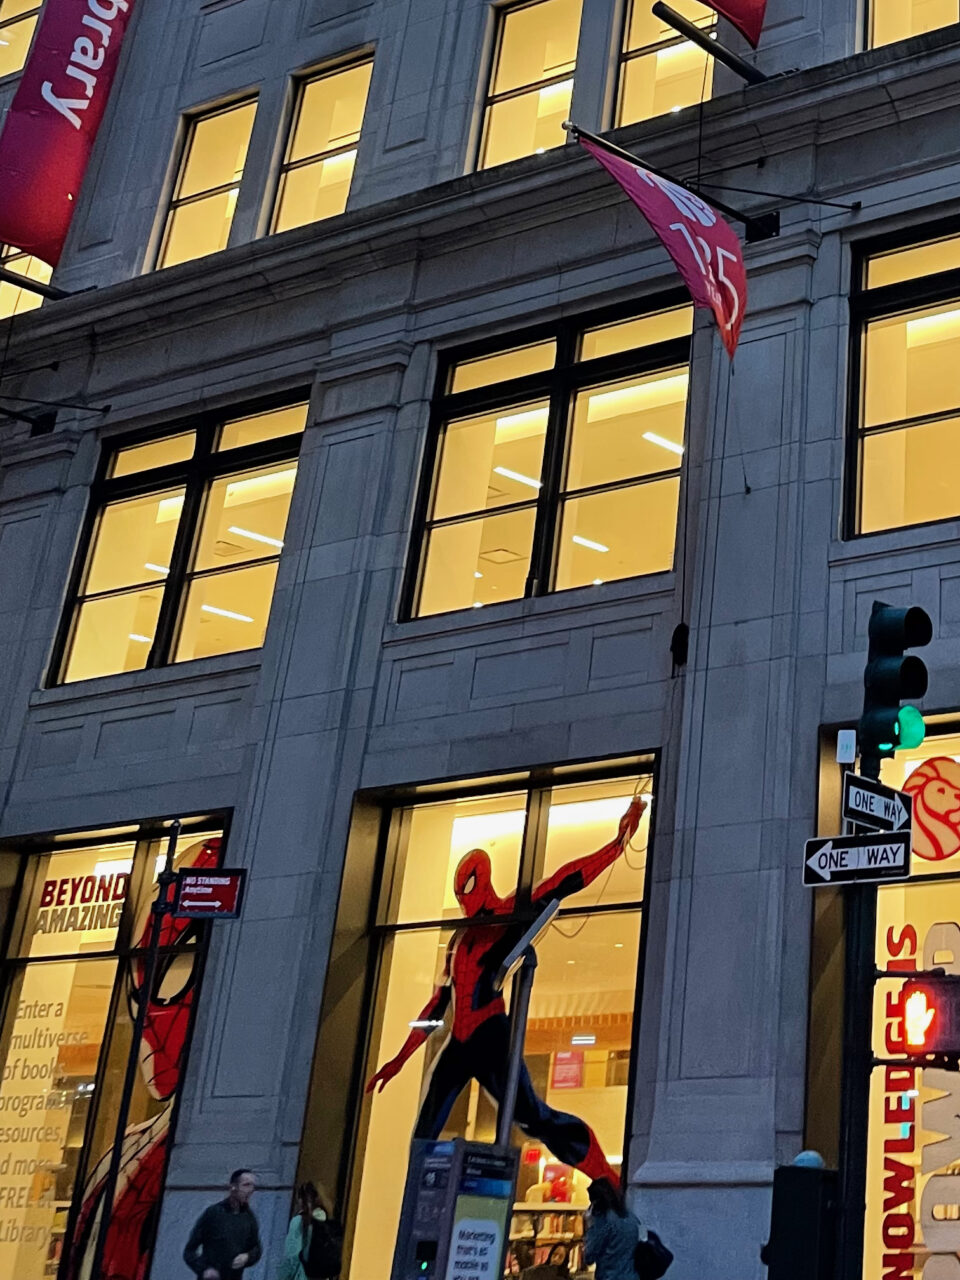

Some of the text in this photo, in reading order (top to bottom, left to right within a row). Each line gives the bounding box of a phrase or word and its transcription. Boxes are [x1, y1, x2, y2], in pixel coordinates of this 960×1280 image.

[855, 790, 903, 822] ONE WAY
[818, 843, 901, 870] ONE WAY
[39, 873, 128, 907] BEYOND
[33, 902, 123, 934] AMAZING
[16, 1000, 63, 1019] Enter a
[11, 1027, 89, 1049] multiverse
[4, 1057, 20, 1080] of
